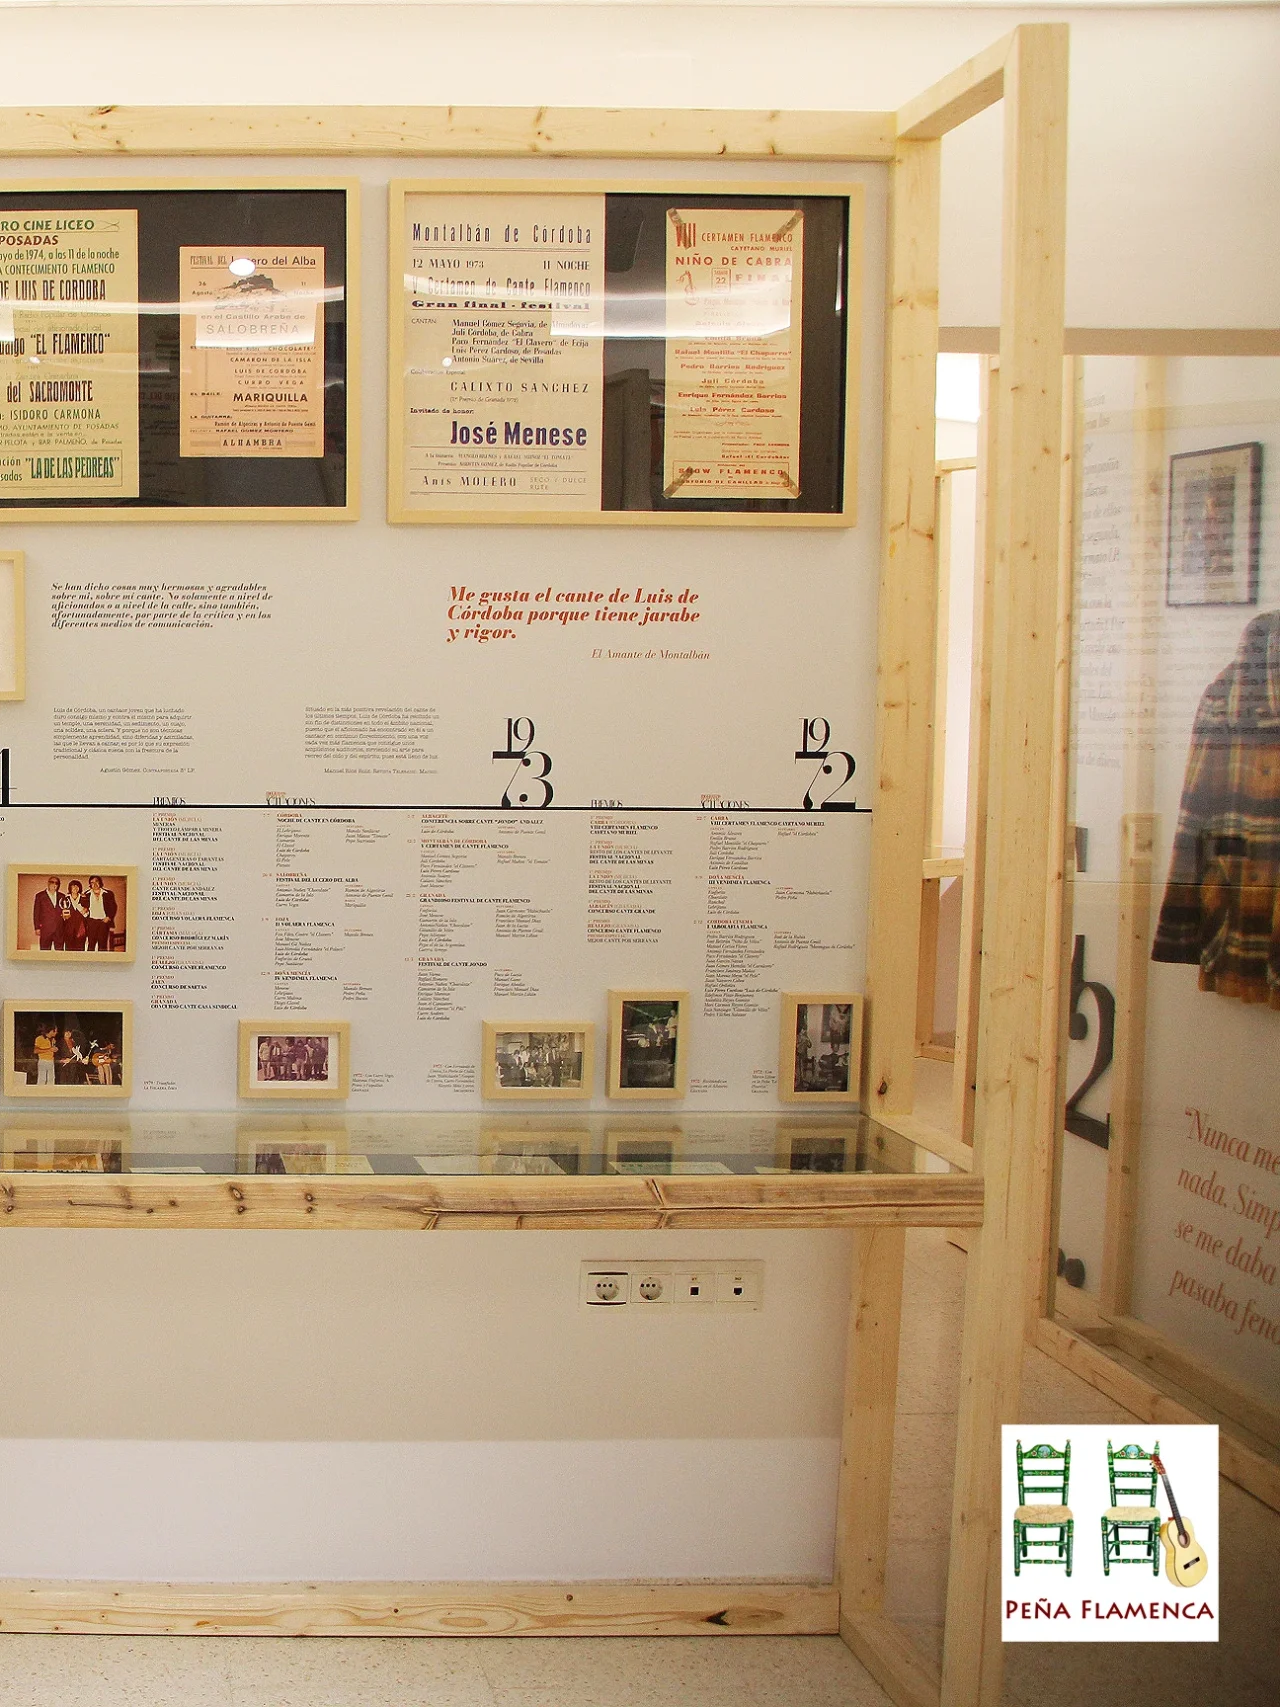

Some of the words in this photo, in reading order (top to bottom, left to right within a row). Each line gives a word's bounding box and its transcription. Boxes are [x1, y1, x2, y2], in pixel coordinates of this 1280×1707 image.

[23, 220, 52, 231] CINE
[55, 219, 94, 230] LICEO
[413, 223, 491, 242] Montalbán
[504, 225, 519, 242] de
[533, 225, 591, 244] Córdoba
[701, 232, 745, 242] CERTAMEN
[750, 233, 793, 243] FLAMENCO
[14, 249, 24, 260] de
[26, 249, 46, 261] 1974,
[55, 248, 66, 259] las
[68, 248, 74, 259] 11
[76, 248, 86, 259] de
[87, 247, 95, 258] la
[96, 247, 119, 258] noche
[675, 253, 713, 265] NIÑO
[721, 257, 737, 266] DE
[746, 257, 792, 266] CABRA
[272, 256, 288, 266] del
[292, 256, 316, 266] Alba
[412, 259, 423, 269] 12
[429, 259, 460, 269] MAYO
[466, 261, 484, 269] 1973
[557, 260, 590, 270] NOCHE
[72, 263, 115, 274] FLAMENCO
[15, 280, 37, 300] LUIS
[42, 279, 55, 300] DE
[59, 279, 106, 300] CORDOBA
[428, 276, 476, 296] Certamen
[485, 277, 497, 296] de
[506, 277, 535, 296] Cante
[544, 278, 591, 297] Flamenco
[411, 300, 458, 308] Gran
[463, 300, 506, 309] final
[520, 301, 590, 310] festival
[206, 321, 300, 334] SALOBREÑA
[7, 381, 21, 402] del
[29, 380, 93, 402] SACROMONTE
[450, 381, 514, 393] CALIXTO
[521, 382, 589, 394] SANCHEZ
[233, 393, 308, 402] MARIQUILLA
[10, 409, 48, 420] ISIDORO
[54, 409, 101, 420] CARMONA
[450, 420, 497, 445] José
[504, 421, 587, 446] Menese
[44, 457, 55, 479] DE
[57, 457, 73, 478] LAS
[460, 476, 517, 487] MOLERO
[207, 585, 214, 593] y
[215, 583, 267, 593] agradables
[449, 586, 476, 602] Me
[480, 589, 530, 607] gusta
[534, 587, 551, 602] el
[555, 590, 604, 603] cante
[608, 588, 630, 603] de
[634, 588, 673, 604] Luis
[677, 588, 699, 604] de
[447, 604, 523, 621] Córdoba
[527, 610, 590, 625] porque
[594, 606, 639, 621] tiene
[637, 606, 700, 626] jarabe
[446, 626, 460, 642] y
[463, 623, 517, 644] rigor.
[591, 648, 602, 659] El
[645, 649, 656, 659] de
[659, 649, 711, 660] Montalbán
[1177, 1168, 1228, 1209] nada.
[1174, 1219, 1194, 1243] se
[1195, 1228, 1224, 1257] me
[1225, 1235, 1277, 1286] daba
[1168, 1270, 1239, 1321] pasaba
